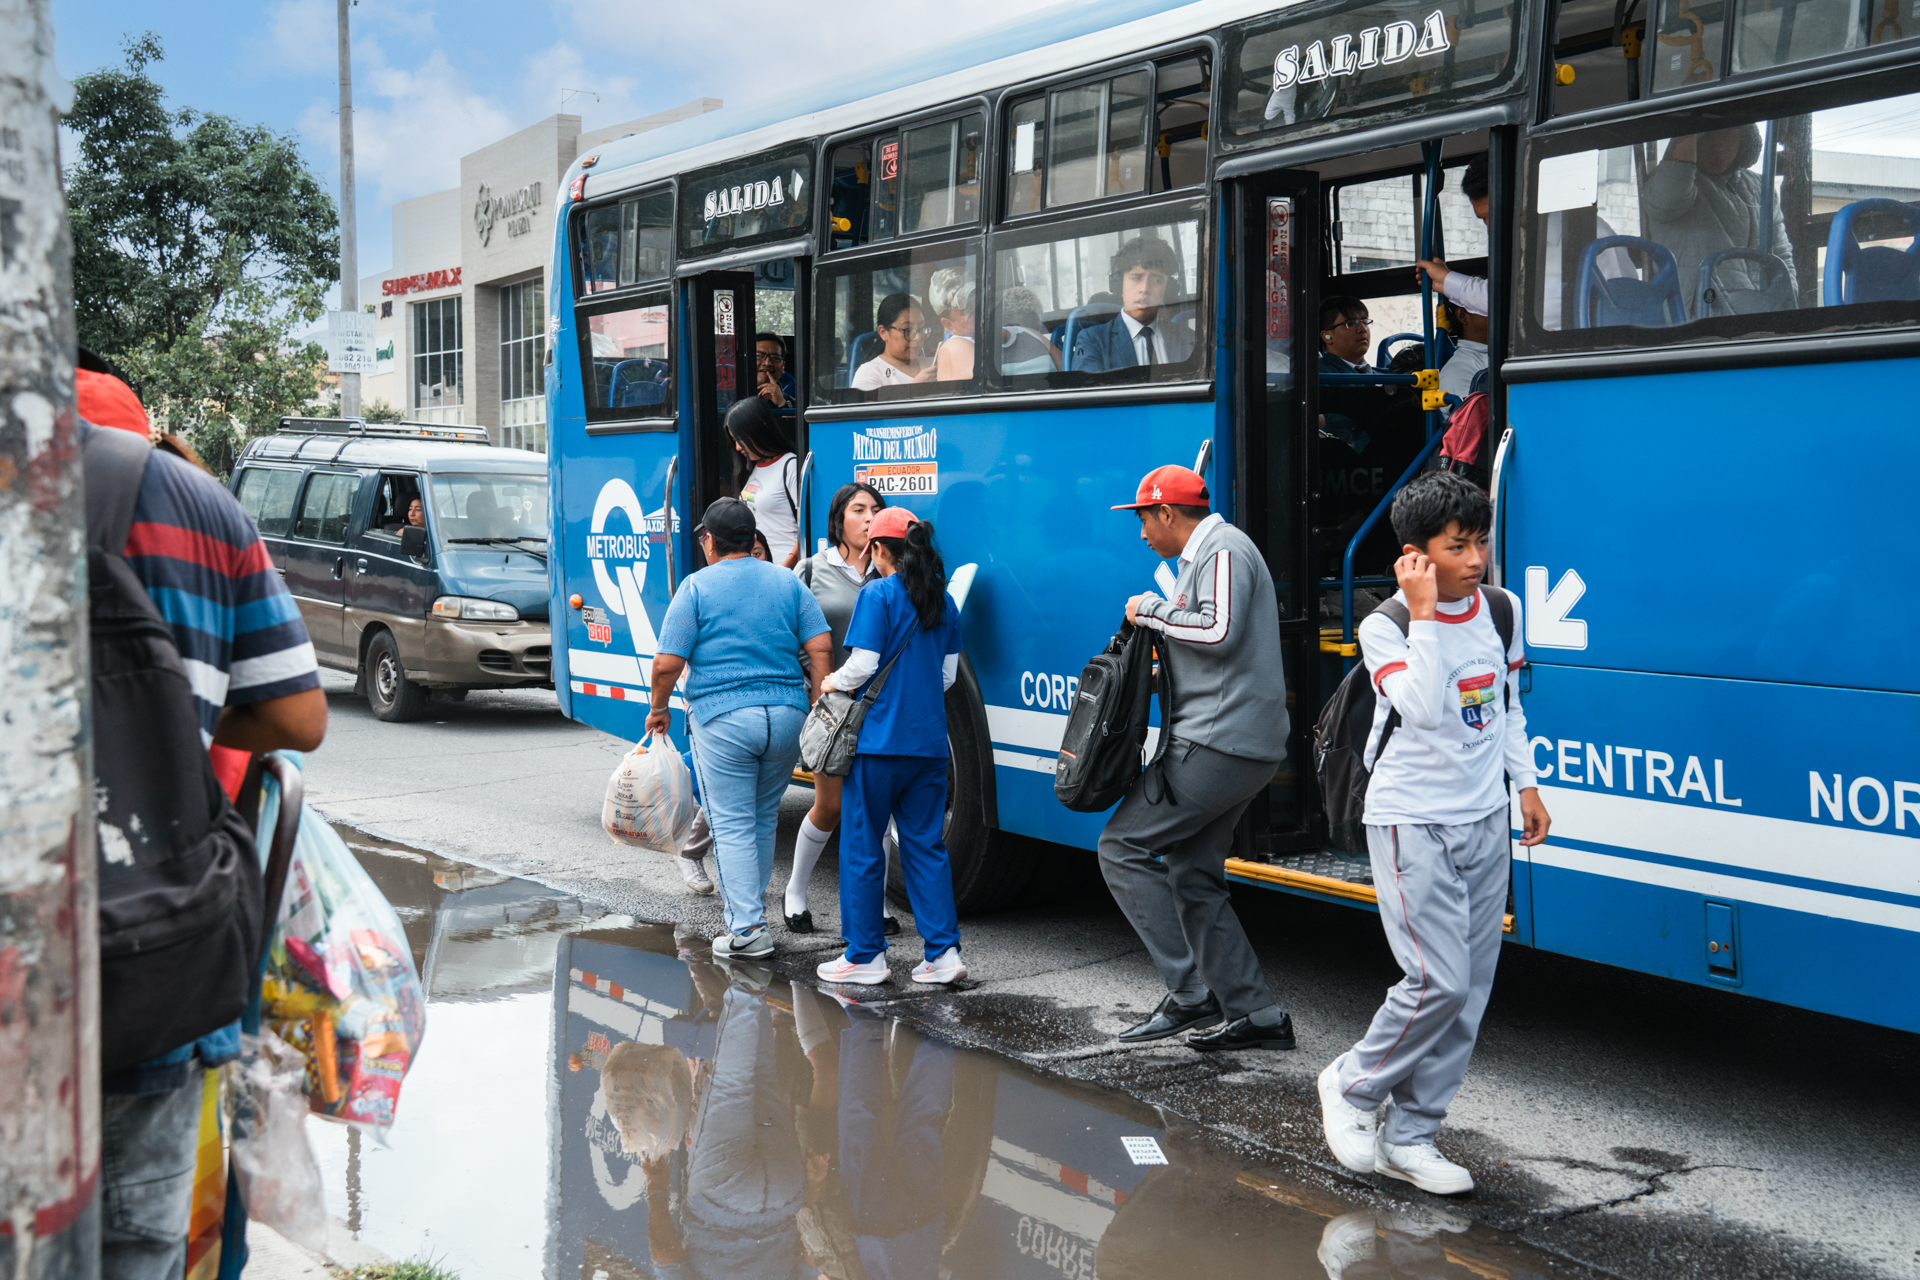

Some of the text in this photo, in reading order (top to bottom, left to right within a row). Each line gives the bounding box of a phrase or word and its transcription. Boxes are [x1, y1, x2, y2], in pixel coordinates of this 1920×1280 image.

[1273, 9, 1451, 91] SALIDA
[704, 175, 784, 221] SALIDA
[382, 267, 462, 296] SUPERMAX
[1271, 229, 1279, 334] PELIGRO
[853, 428, 937, 460] MITAD DEL MUNDO
[869, 476, 932, 492] PAC-2601
[888, 465, 920, 475] ECUADOR
[587, 535, 650, 560] METROBUS
[584, 610, 594, 620] ECU
[590, 625, 609, 640] 911
[1529, 736, 1920, 830] CENTRAL NOR
